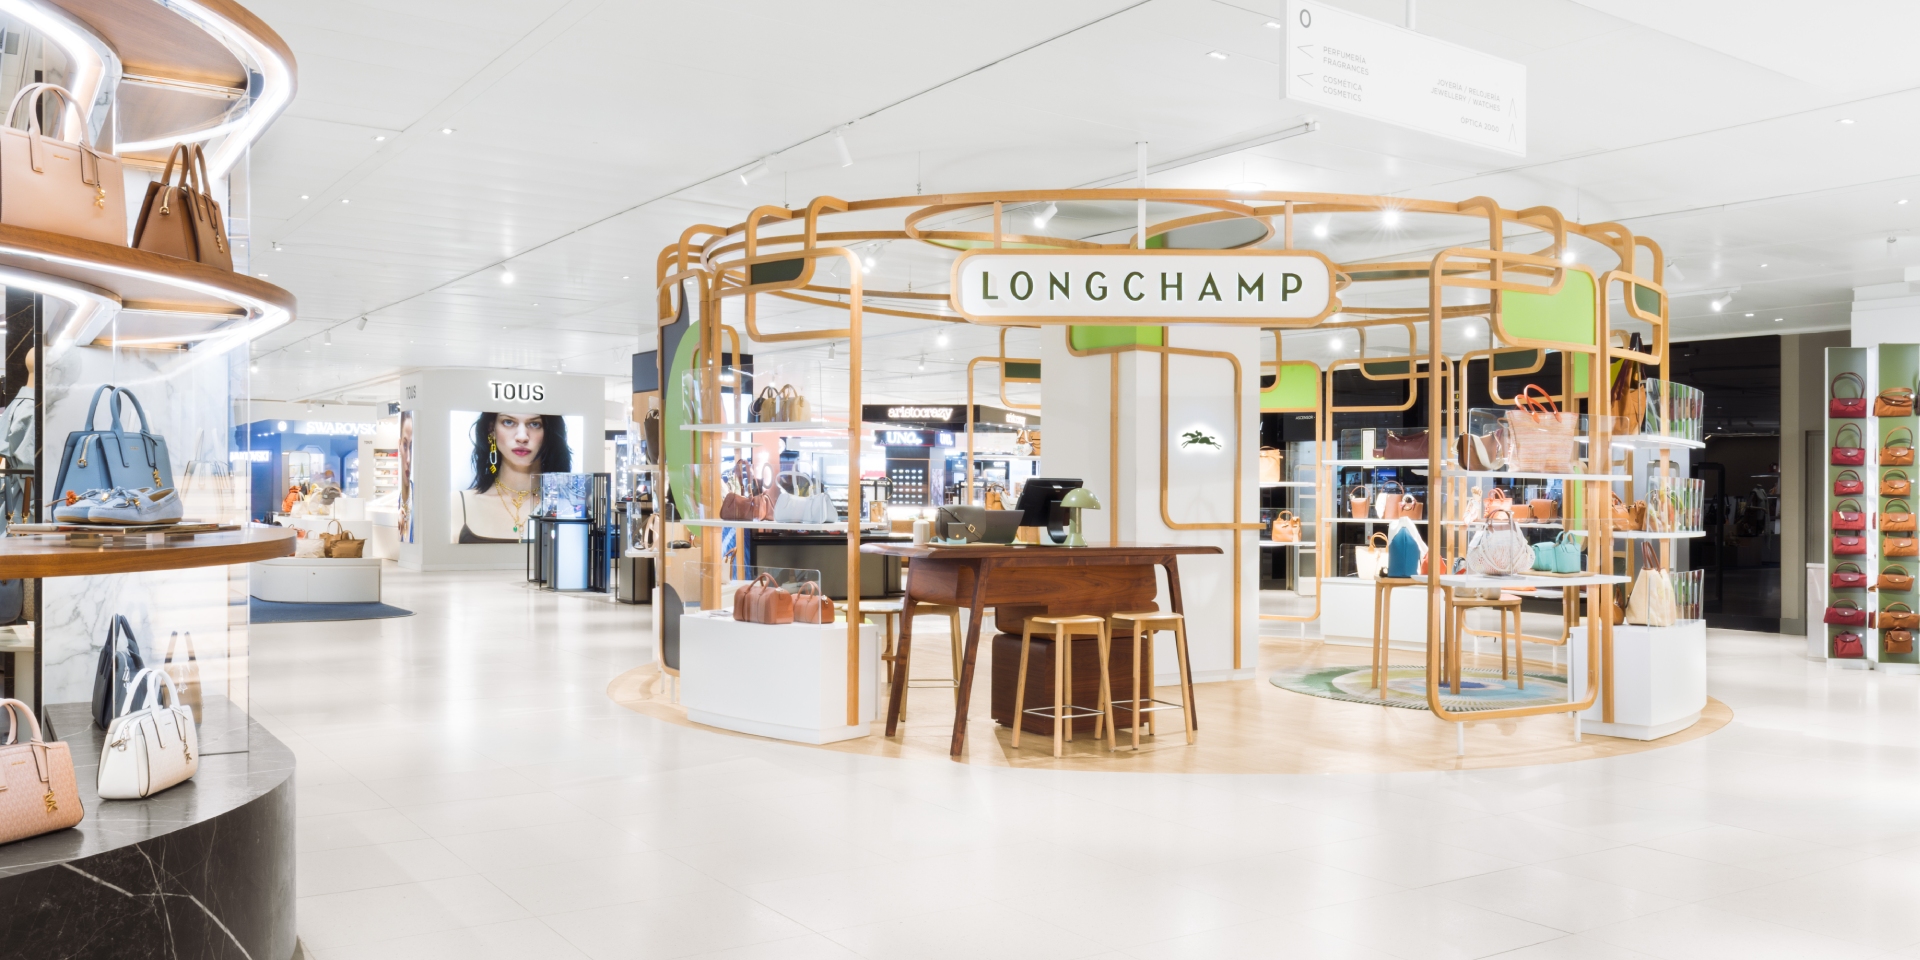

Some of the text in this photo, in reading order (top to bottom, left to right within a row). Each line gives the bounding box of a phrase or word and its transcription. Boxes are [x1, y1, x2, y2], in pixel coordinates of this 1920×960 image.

[1323, 46, 1366, 64] PERFUMERÍA
[1323, 57, 1369, 76] FRAGRANCES
[1323, 75, 1362, 92] COSMÉTICA
[1437, 79, 1463, 91] JOYERÍA
[1468, 87, 1501, 102] RELOJERÍA
[1323, 86, 1362, 102] COSMETICS
[1431, 87, 1467, 102] JEWELLERY
[1472, 98, 1501, 112] WATCHES
[1460, 116, 1500, 133] ÓPTICA 2000
[982, 270, 1303, 302] LONGCHAMP
[405, 385, 416, 400] TOUS
[491, 382, 544, 401] TOUS
[888, 406, 953, 421] aristocrazy
[306, 421, 377, 435] SWAROVSK
